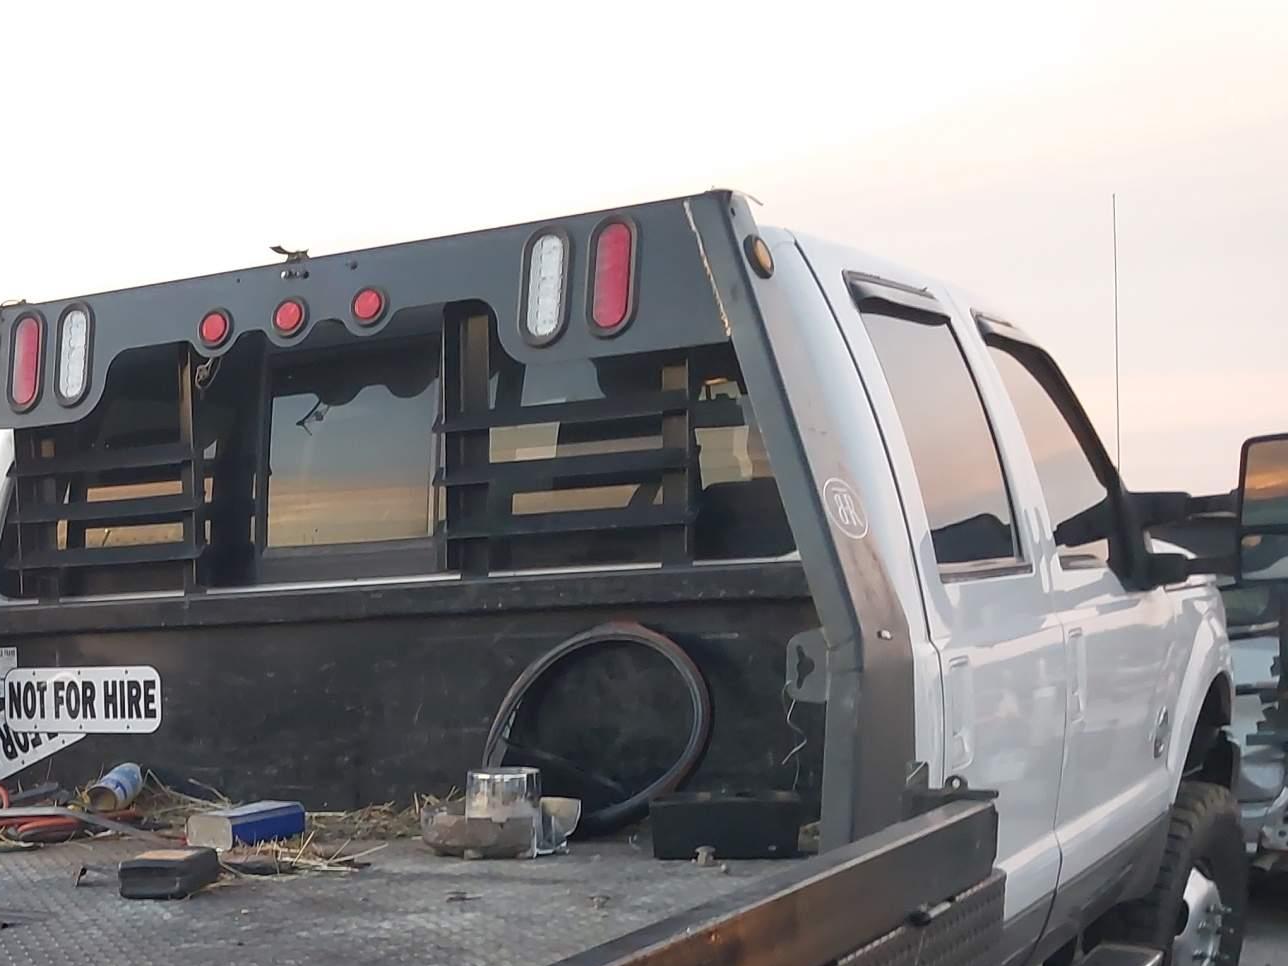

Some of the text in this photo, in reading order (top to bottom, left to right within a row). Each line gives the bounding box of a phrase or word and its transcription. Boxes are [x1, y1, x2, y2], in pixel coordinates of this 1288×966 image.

[8, 679, 157, 719] NOT FOR HIRE
